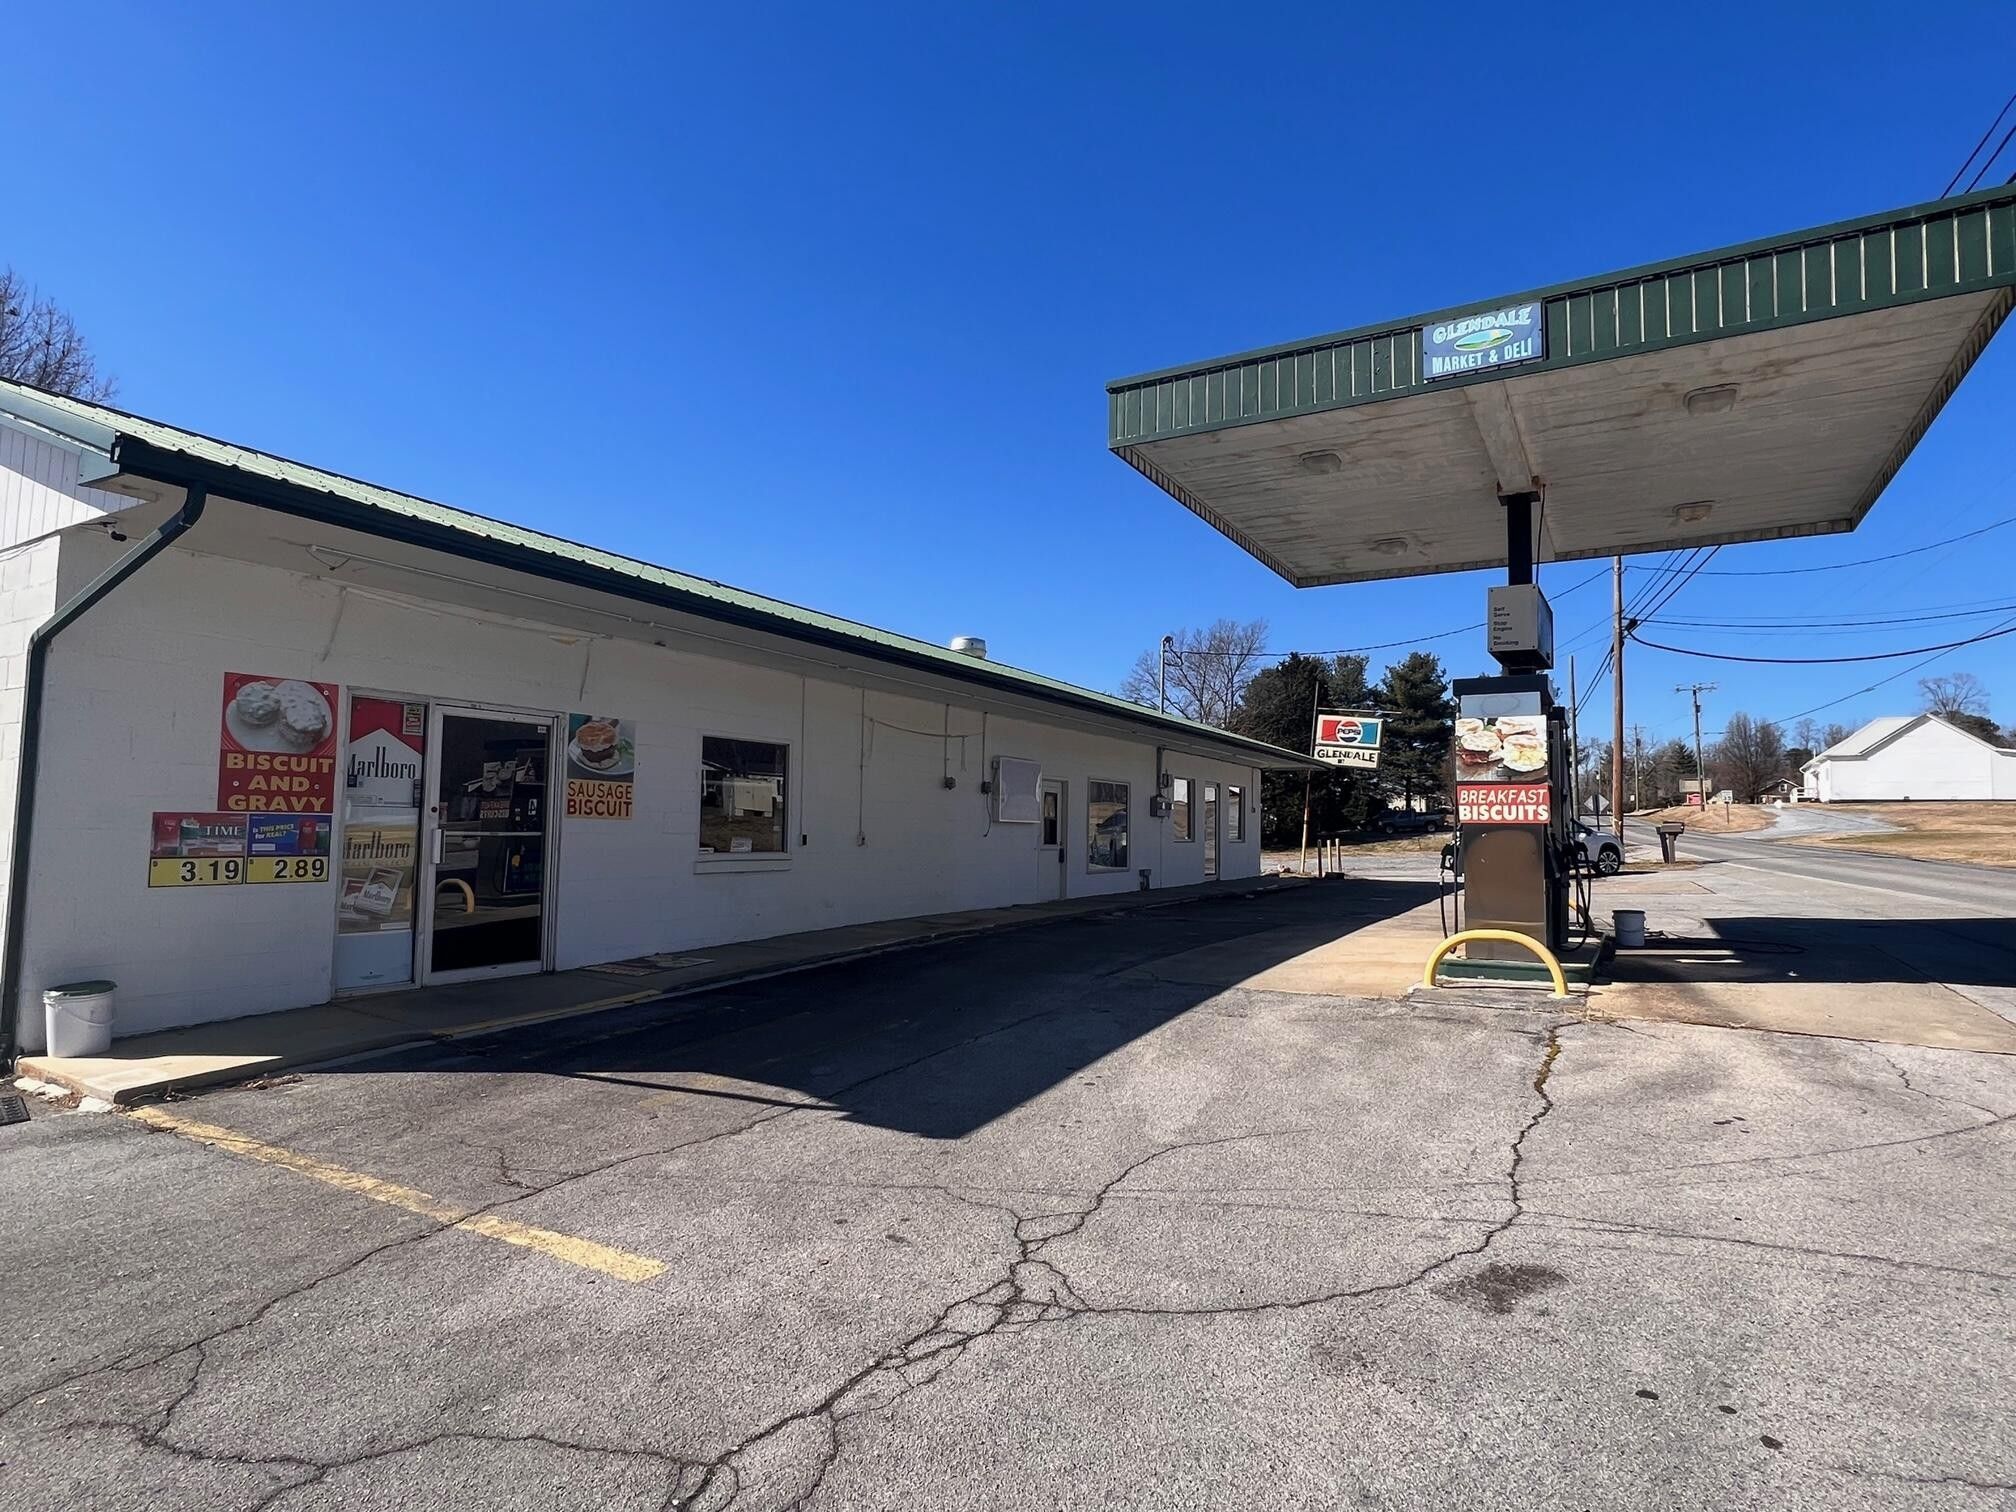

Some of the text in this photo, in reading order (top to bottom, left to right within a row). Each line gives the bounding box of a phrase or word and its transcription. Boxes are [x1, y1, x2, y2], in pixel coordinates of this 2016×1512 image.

[1432, 306, 1533, 344] GLENDALE
[1432, 337, 1532, 374] MARKET & DELI
[227, 753, 333, 773] BISCUIT
[1317, 749, 1376, 762] GLENDALE
[248, 775, 310, 792] AND
[568, 781, 632, 800] SAUSAGE
[228, 795, 326, 811] GRAVY
[1460, 789, 1547, 804] BREAKFAST
[567, 799, 632, 816] BISCUIT
[1459, 804, 1549, 821] BISCUITS
[205, 825, 241, 836] TIME
[181, 860, 239, 882] 3.19
[274, 859, 325, 879] 2.89
